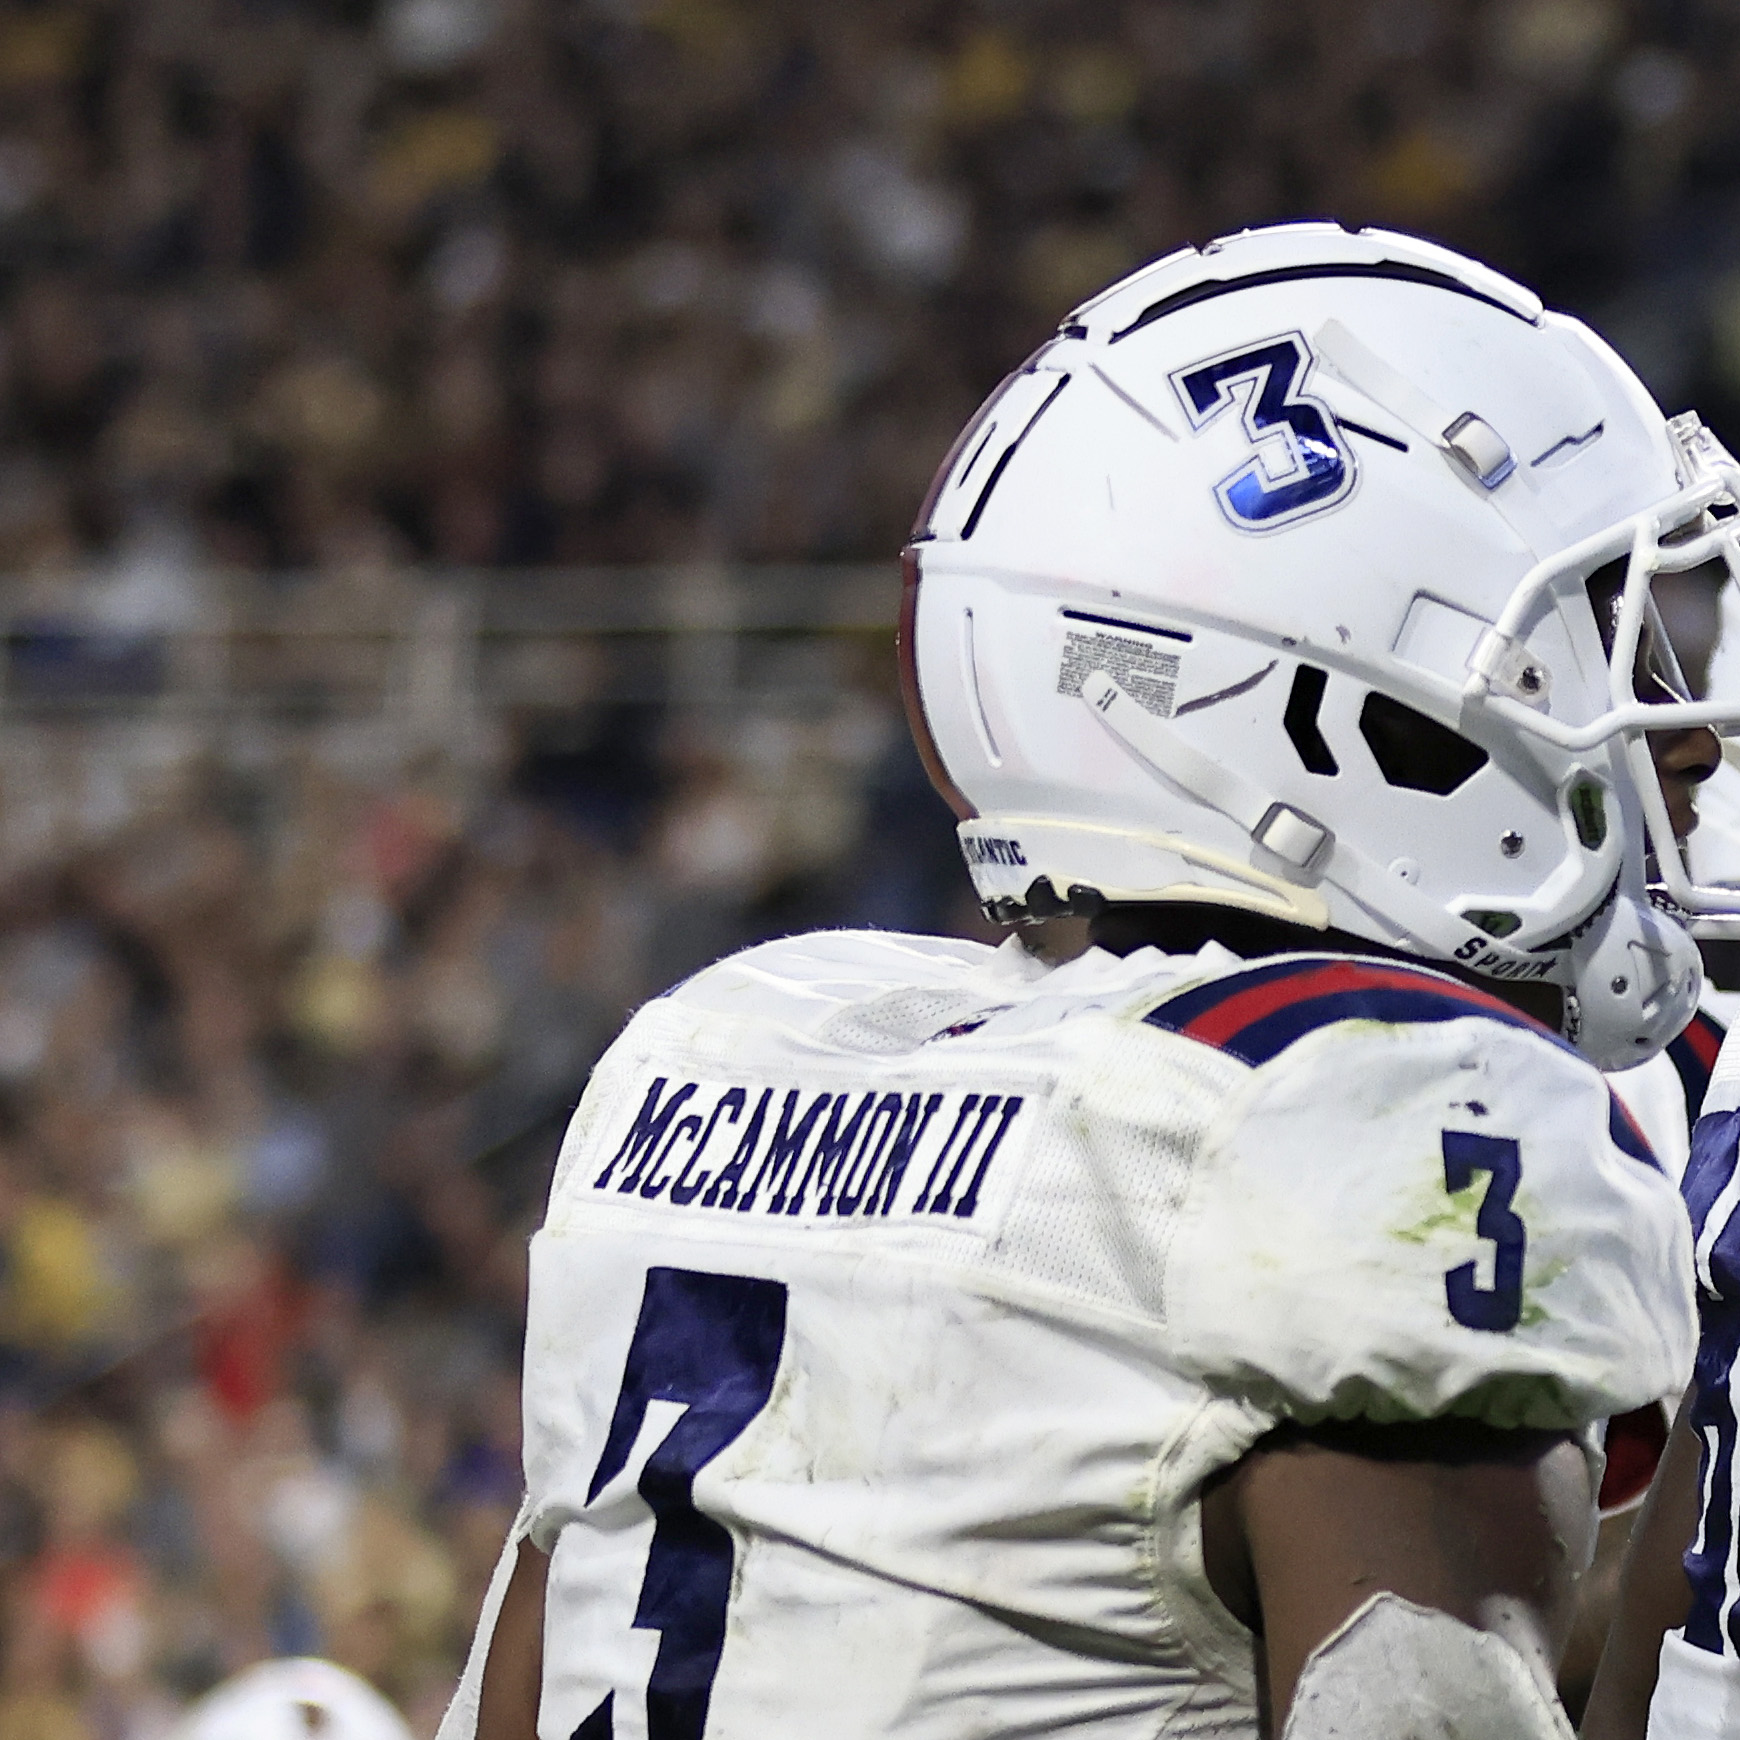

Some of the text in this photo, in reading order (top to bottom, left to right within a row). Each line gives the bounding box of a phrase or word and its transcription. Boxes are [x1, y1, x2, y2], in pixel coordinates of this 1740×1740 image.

[1168, 331, 1359, 535] 3
[593, 1077, 1024, 1217] McCAMMON III
[1442, 1129, 1526, 1332] 3
